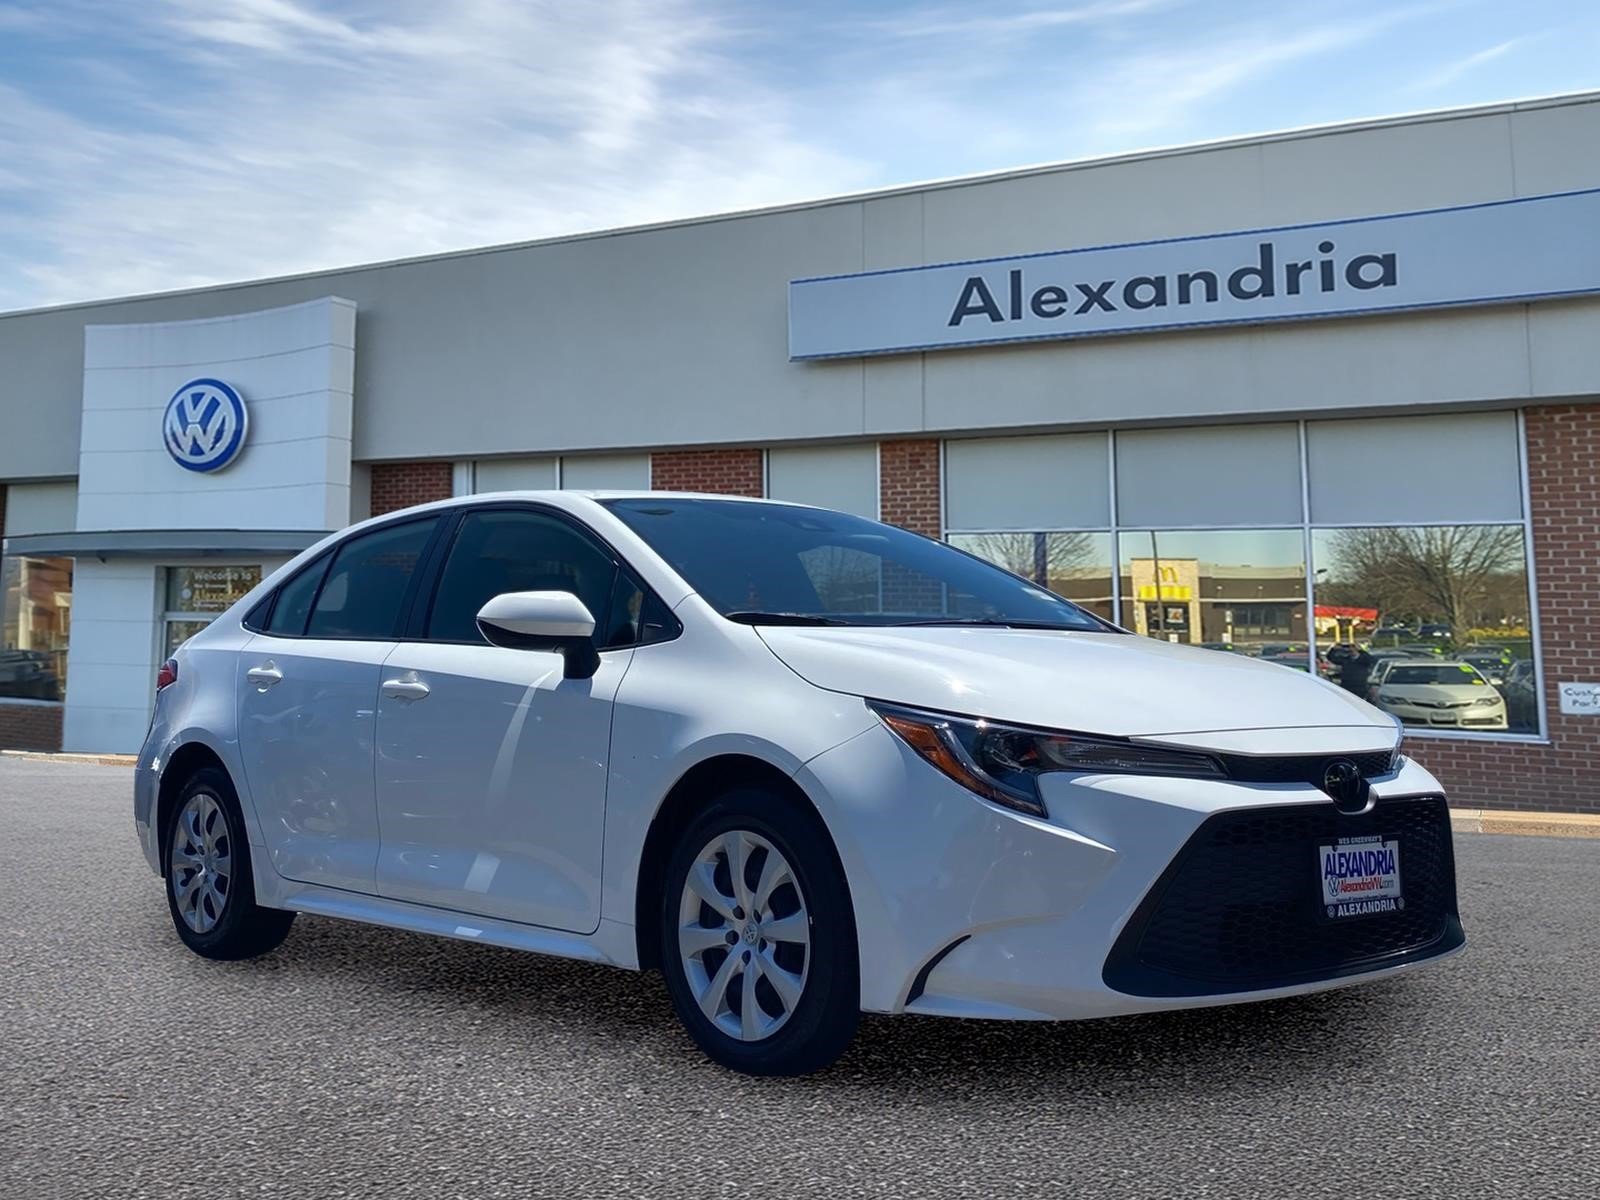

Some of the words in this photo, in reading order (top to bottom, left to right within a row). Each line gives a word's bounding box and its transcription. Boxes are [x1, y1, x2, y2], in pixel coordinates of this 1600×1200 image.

[947, 240, 1398, 327] Alexandria
[165, 381, 242, 468] VW
[193, 570, 238, 581] Welcome
[1324, 849, 1396, 880] ALEXANDRIA
[1337, 899, 1397, 917] ALEXANDRIA
